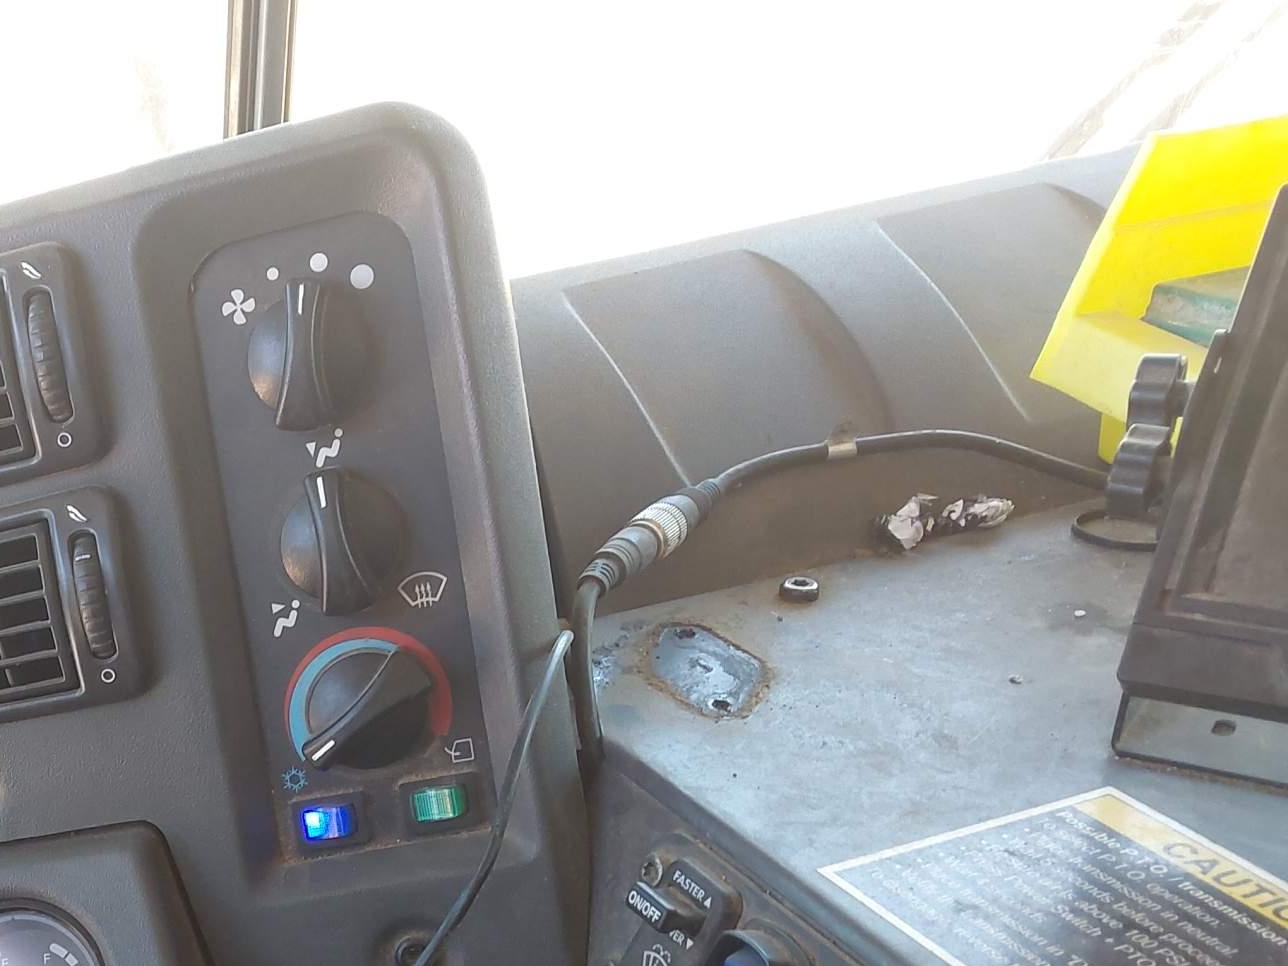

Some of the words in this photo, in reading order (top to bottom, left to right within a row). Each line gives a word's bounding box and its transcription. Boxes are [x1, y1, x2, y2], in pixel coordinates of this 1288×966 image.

[673, 870, 705, 901] FASTER
[1052, 810, 1126, 849] Possible
[1174, 880, 1288, 947] transmission
[628, 890, 662, 923] ON/OFF
[1048, 903, 1107, 936] Switch
[1109, 901, 1169, 934] before
[669, 930, 685, 946] ER
[1071, 898, 1128, 929] above
[1122, 929, 1160, 949] 100
[1156, 910, 1182, 922] in
[1174, 920, 1244, 958] neutral.
[44, 953, 51, 964] F
[1044, 943, 1069, 956] in
